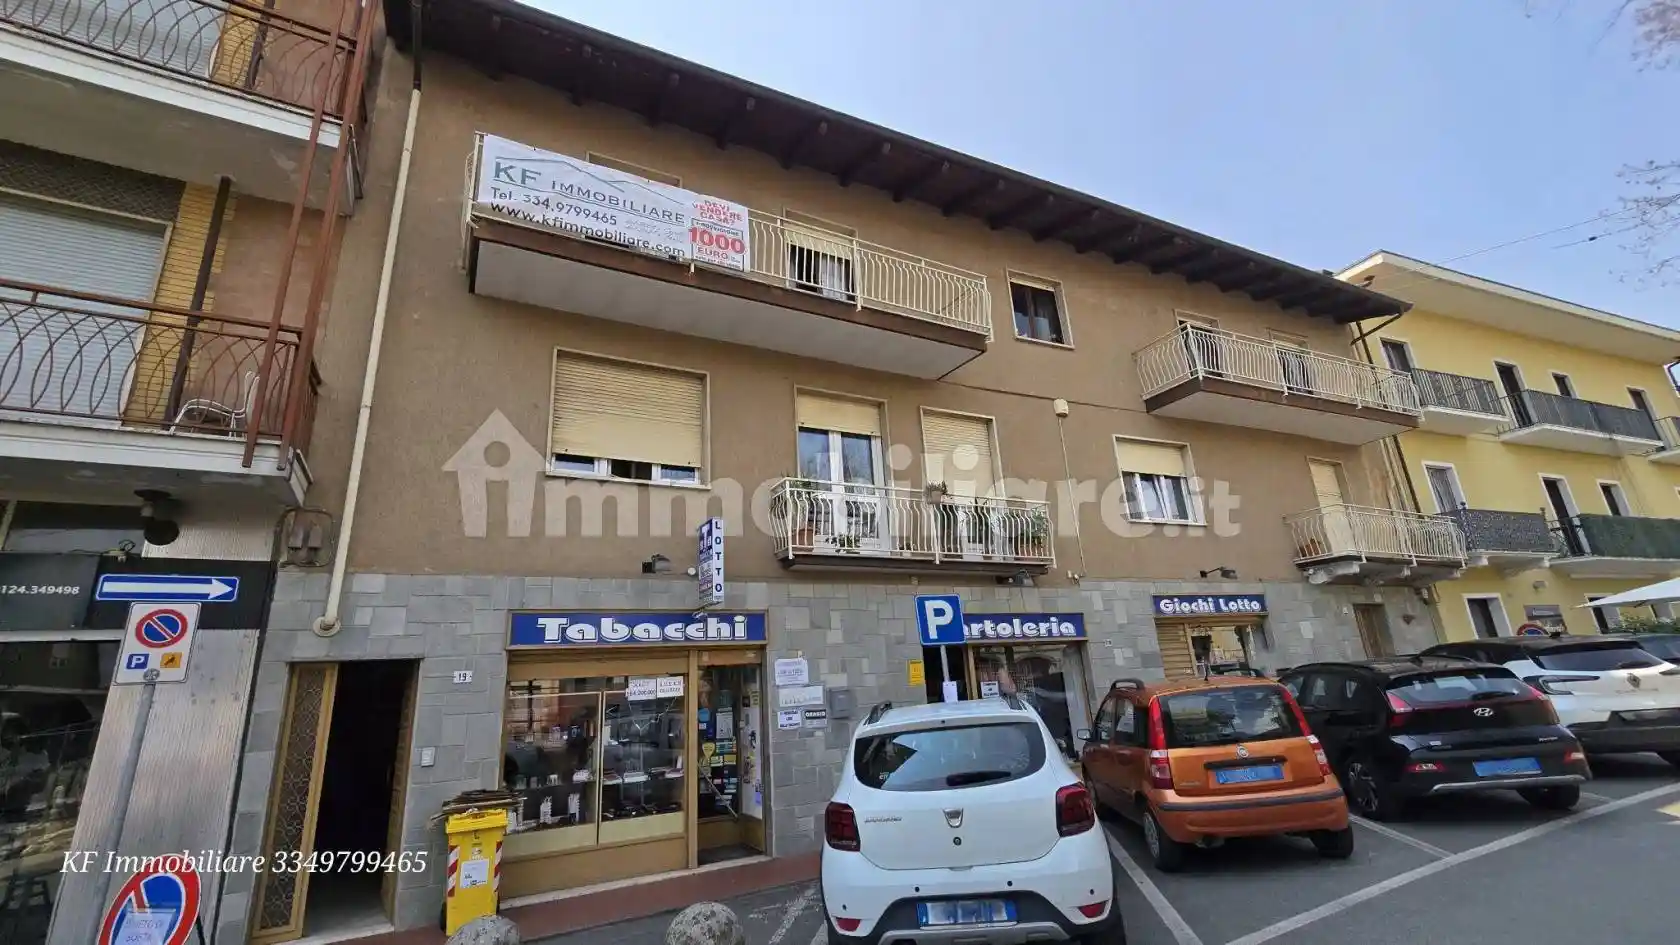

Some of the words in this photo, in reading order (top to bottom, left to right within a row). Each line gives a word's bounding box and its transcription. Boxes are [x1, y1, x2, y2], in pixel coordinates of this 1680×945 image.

[491, 187, 518, 201] Tel.
[523, 194, 618, 226] 334.9799465
[495, 161, 542, 186] KF
[550, 180, 685, 224] IMMOBILIARE
[491, 202, 685, 257] www.kfimmobiliare.com
[688, 226, 746, 255] 1000
[697, 247, 729, 259] EURO
[714, 520, 723, 593] LOTTO
[0, 585, 80, 595] 124.349498
[924, 600, 954, 639] P
[1159, 597, 1216, 613] Giochi
[1219, 598, 1261, 613] Lotto
[536, 616, 748, 643] Tabacchi
[130, 655, 145, 668] P
